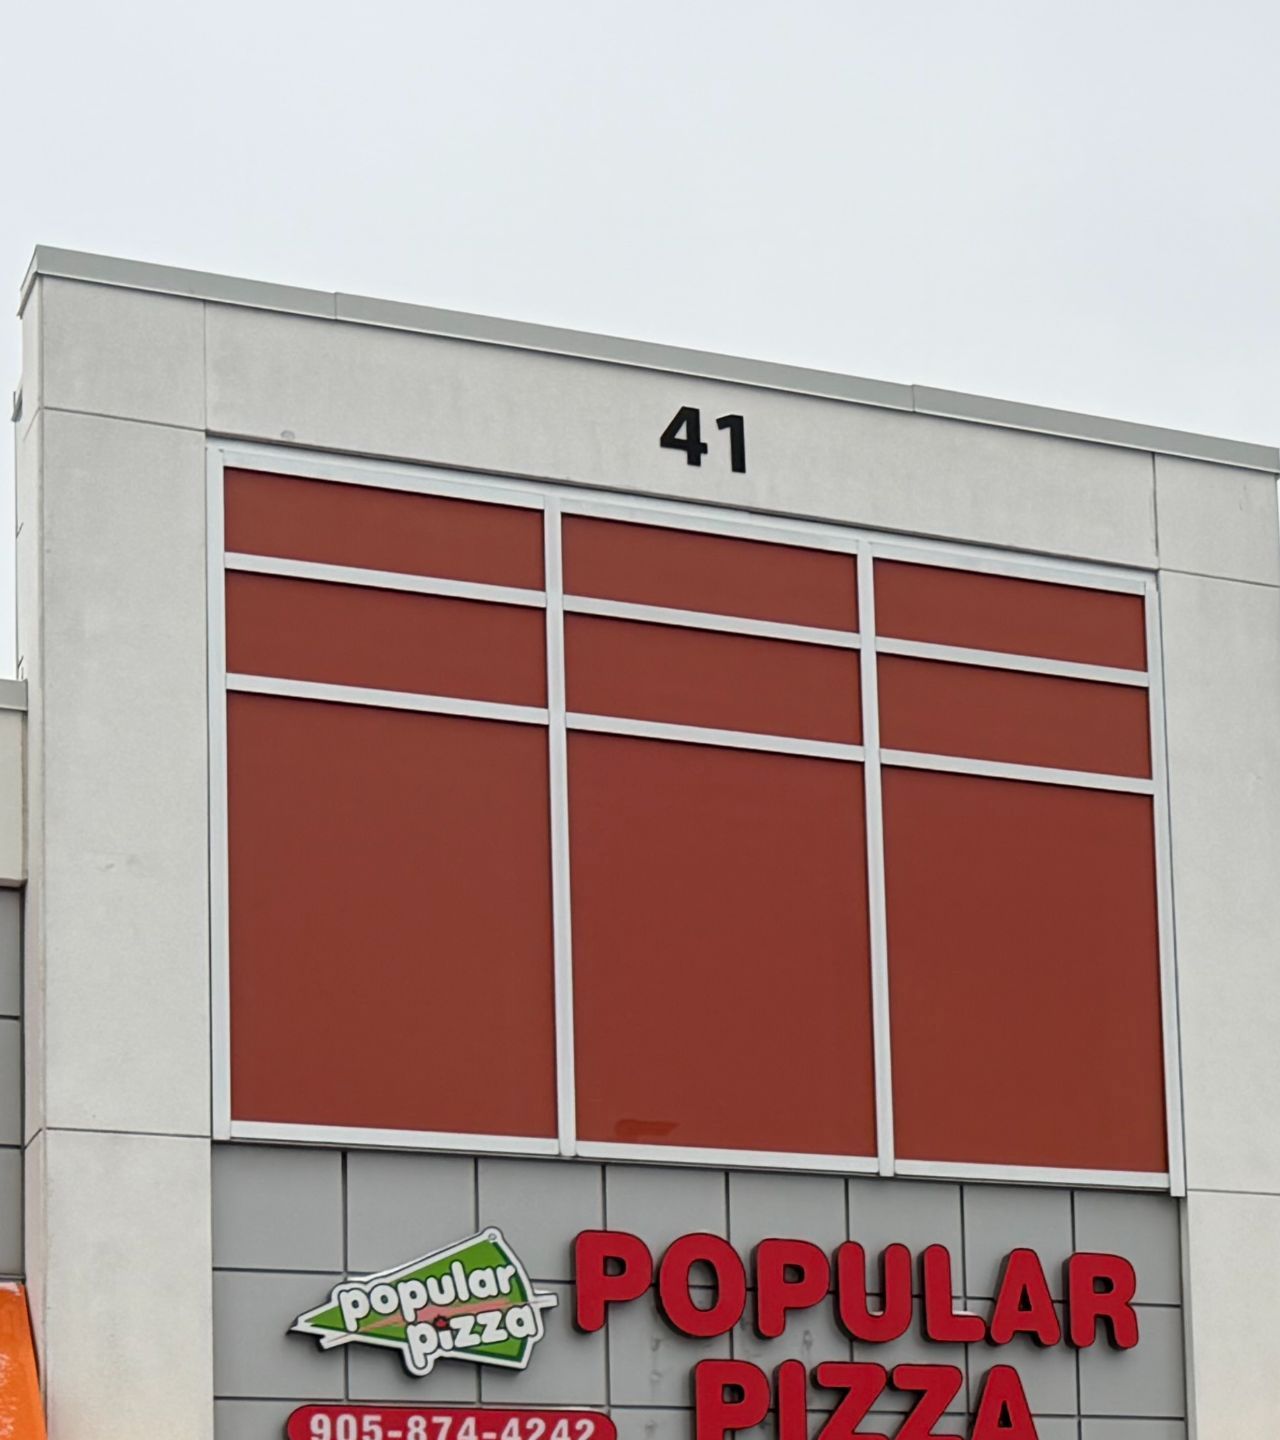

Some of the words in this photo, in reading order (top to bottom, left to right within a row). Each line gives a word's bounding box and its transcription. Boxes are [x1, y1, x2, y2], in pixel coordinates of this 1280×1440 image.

[660, 406, 746, 473] 41
[338, 1258, 518, 1335] popular
[575, 1229, 1139, 1349] POPULAR
[405, 1303, 538, 1378] pizza
